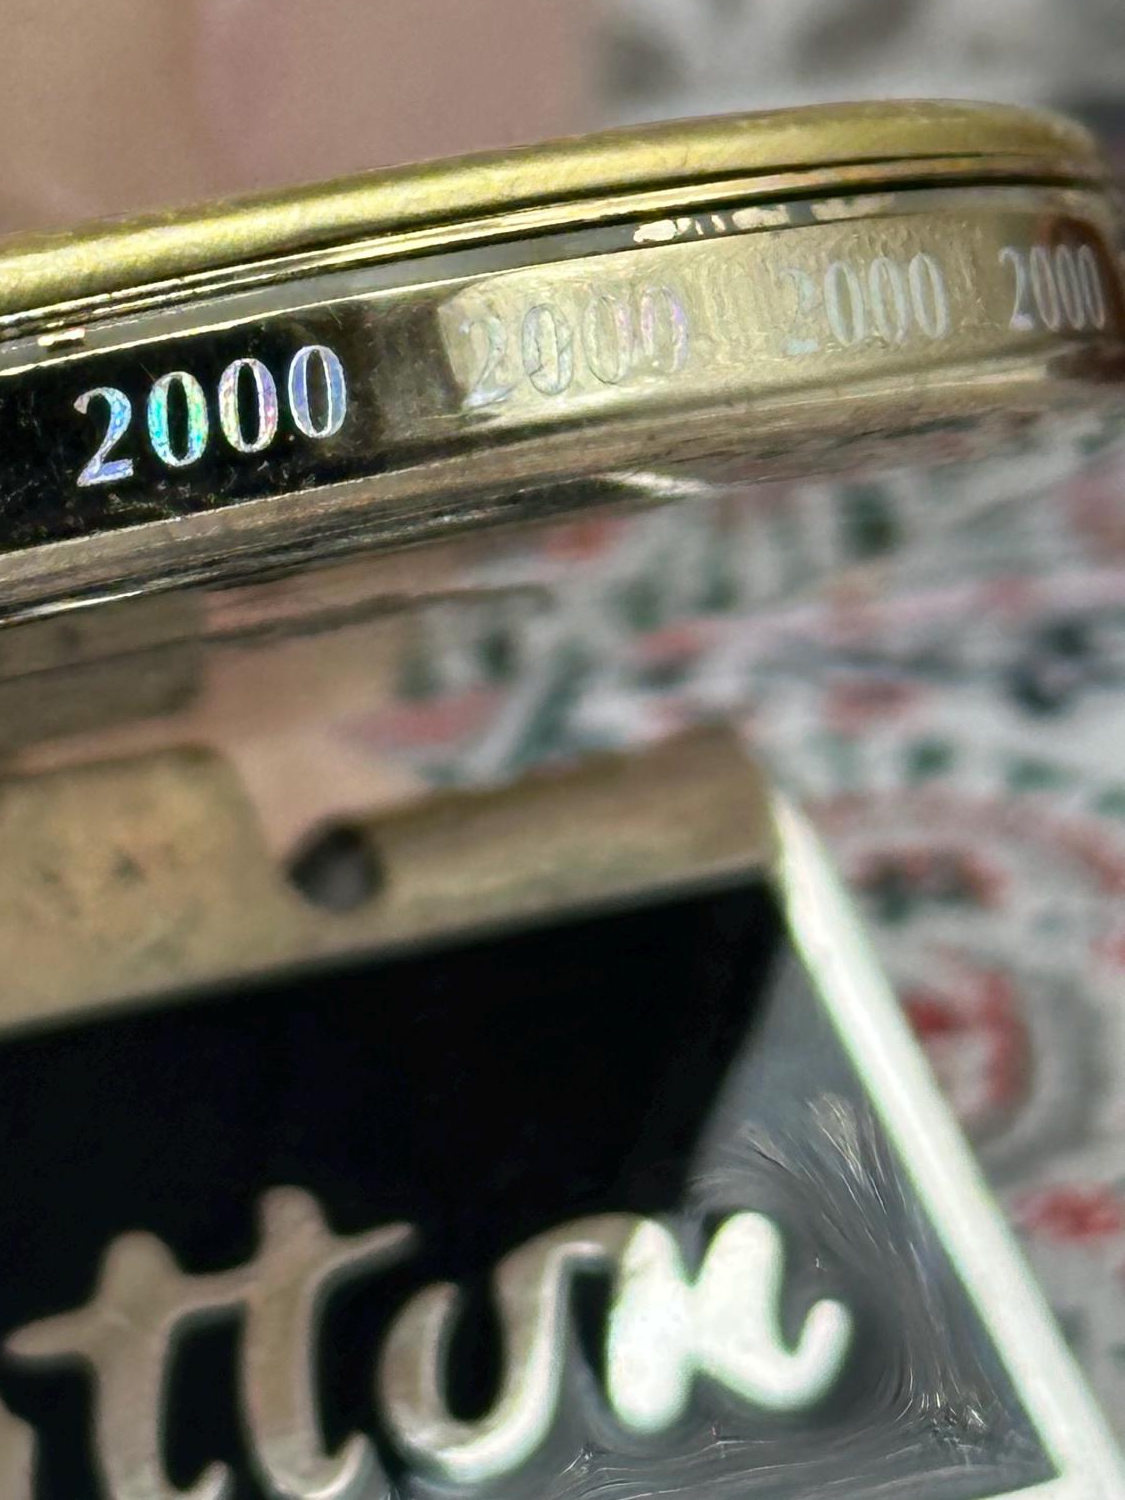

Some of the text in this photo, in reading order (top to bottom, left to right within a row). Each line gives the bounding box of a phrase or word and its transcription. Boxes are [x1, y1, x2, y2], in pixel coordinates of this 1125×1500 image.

[74, 344, 348, 488] 2000
[457, 284, 690, 412] 2000
[779, 250, 952, 358] 2000
[997, 242, 1106, 333] 2000
